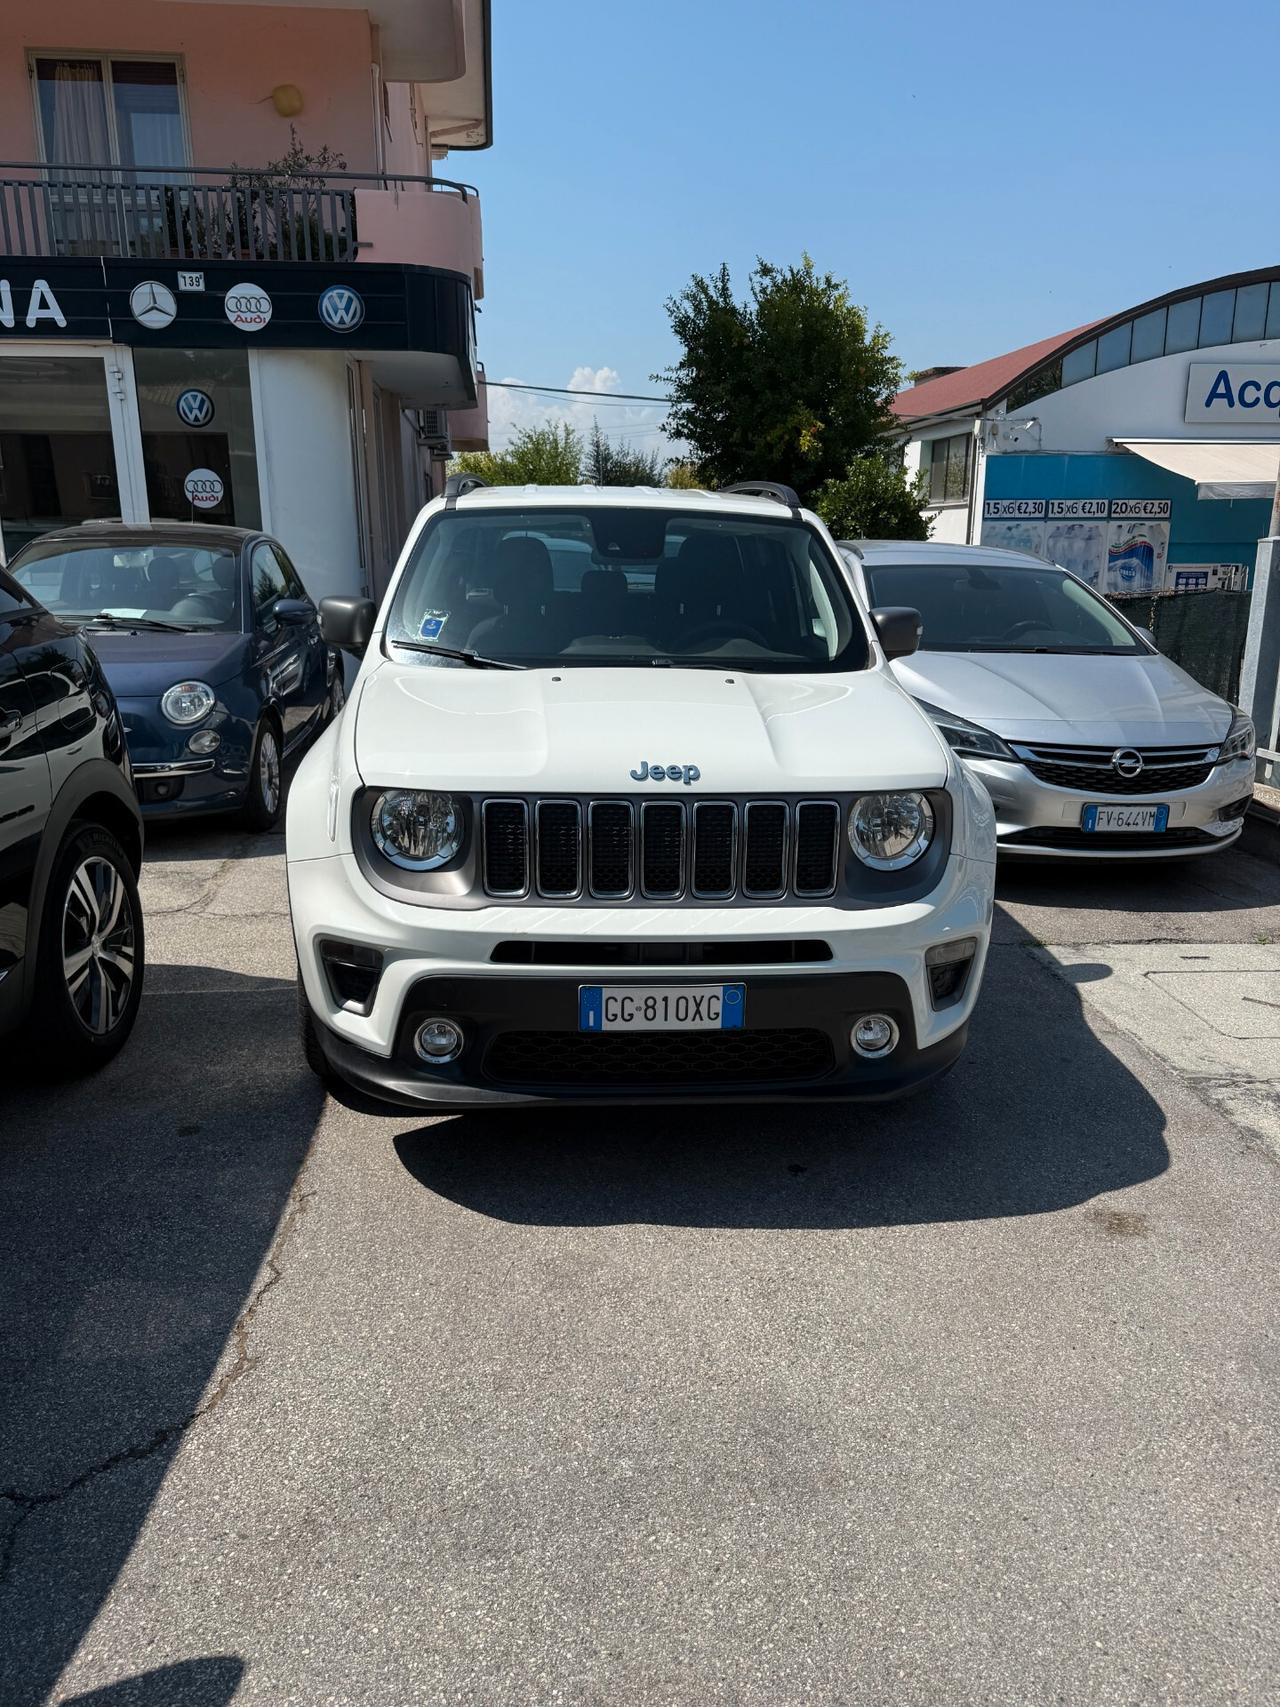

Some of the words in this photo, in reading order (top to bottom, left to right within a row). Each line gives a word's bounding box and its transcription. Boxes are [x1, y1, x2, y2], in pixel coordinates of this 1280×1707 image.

[233, 314, 266, 324] Audi
[1017, 502, 1044, 516] €2,30
[1081, 502, 1106, 514] €2,10
[1143, 502, 1169, 516] €2,50
[630, 760, 701, 786] Jeep
[605, 996, 634, 1022] GG
[644, 995, 720, 1022] 810XG
